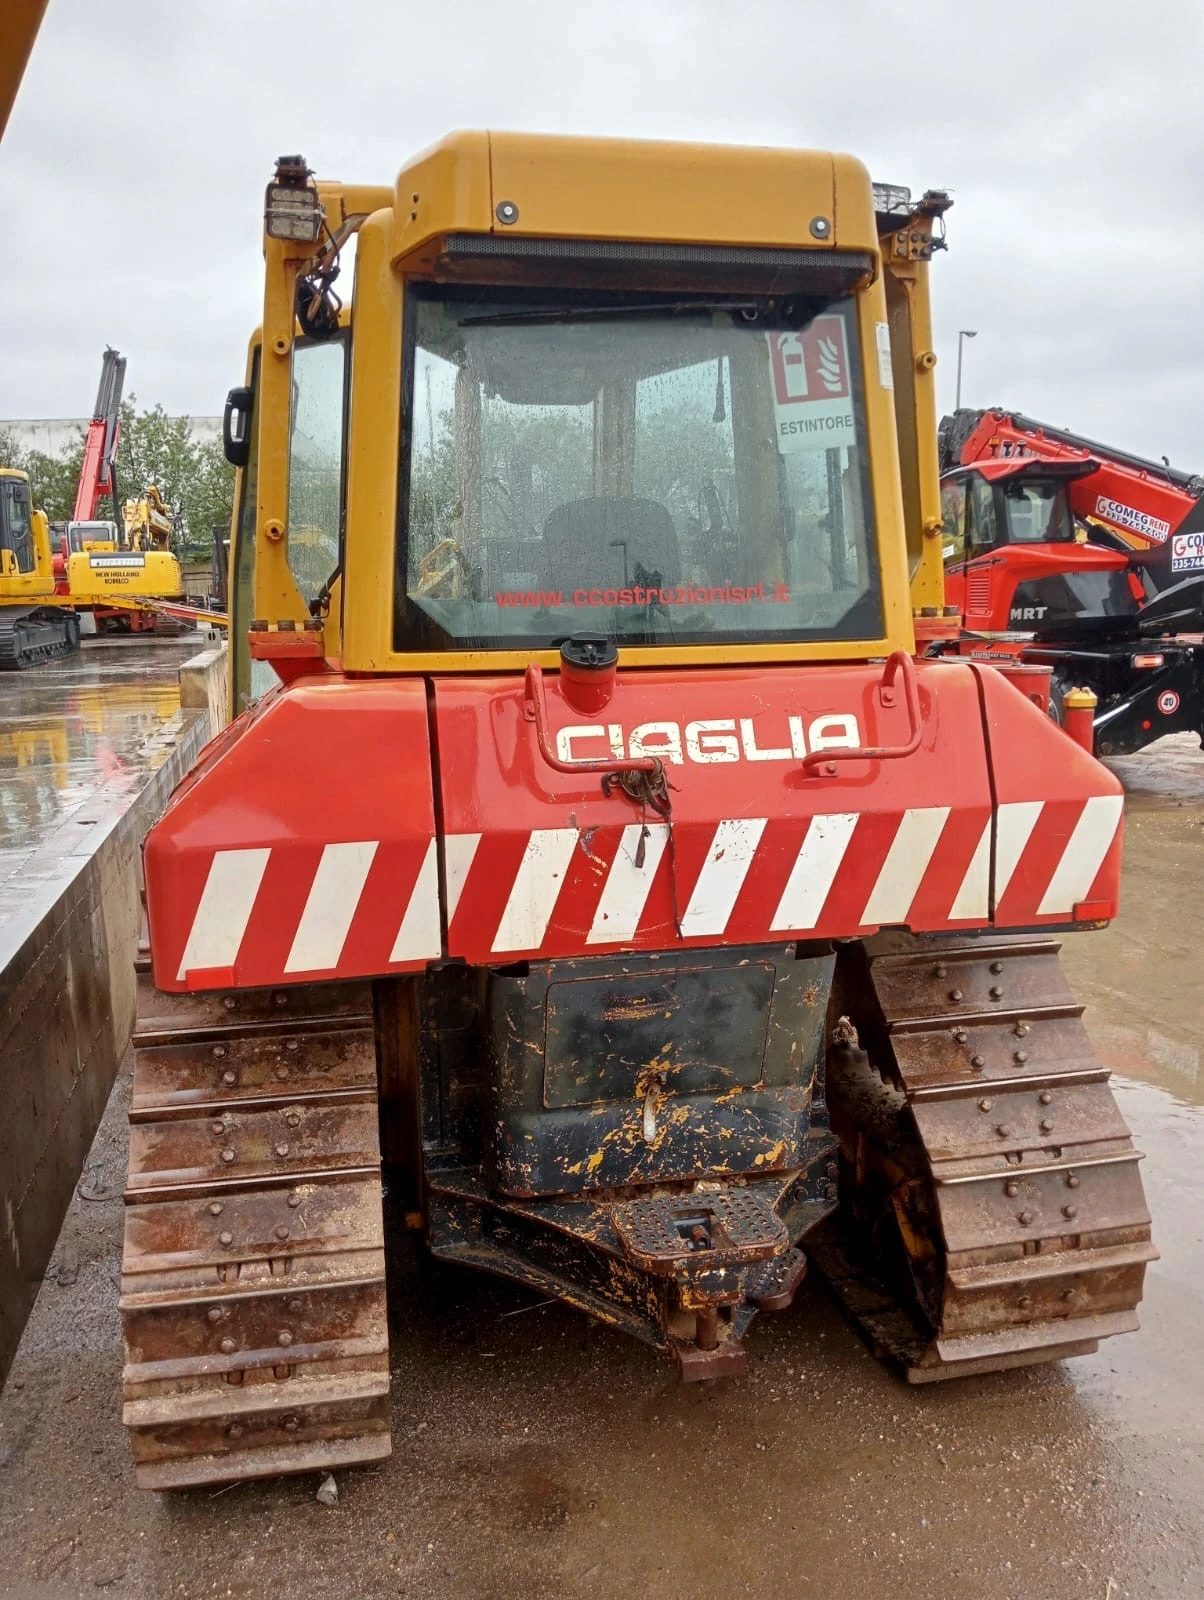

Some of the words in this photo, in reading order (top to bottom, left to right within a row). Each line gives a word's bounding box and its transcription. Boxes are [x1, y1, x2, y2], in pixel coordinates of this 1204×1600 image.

[780, 415, 853, 435] ESTINTORE
[1108, 501, 1149, 525] COMEG
[1149, 519, 1169, 533] RENT
[1187, 534, 1204, 549] CO
[495, 580, 790, 608] www.ccostruzionisrl.it
[1010, 607, 1048, 620] MRT
[1163, 697, 1174, 707] 40
[556, 713, 861, 765] CIAGLIA
